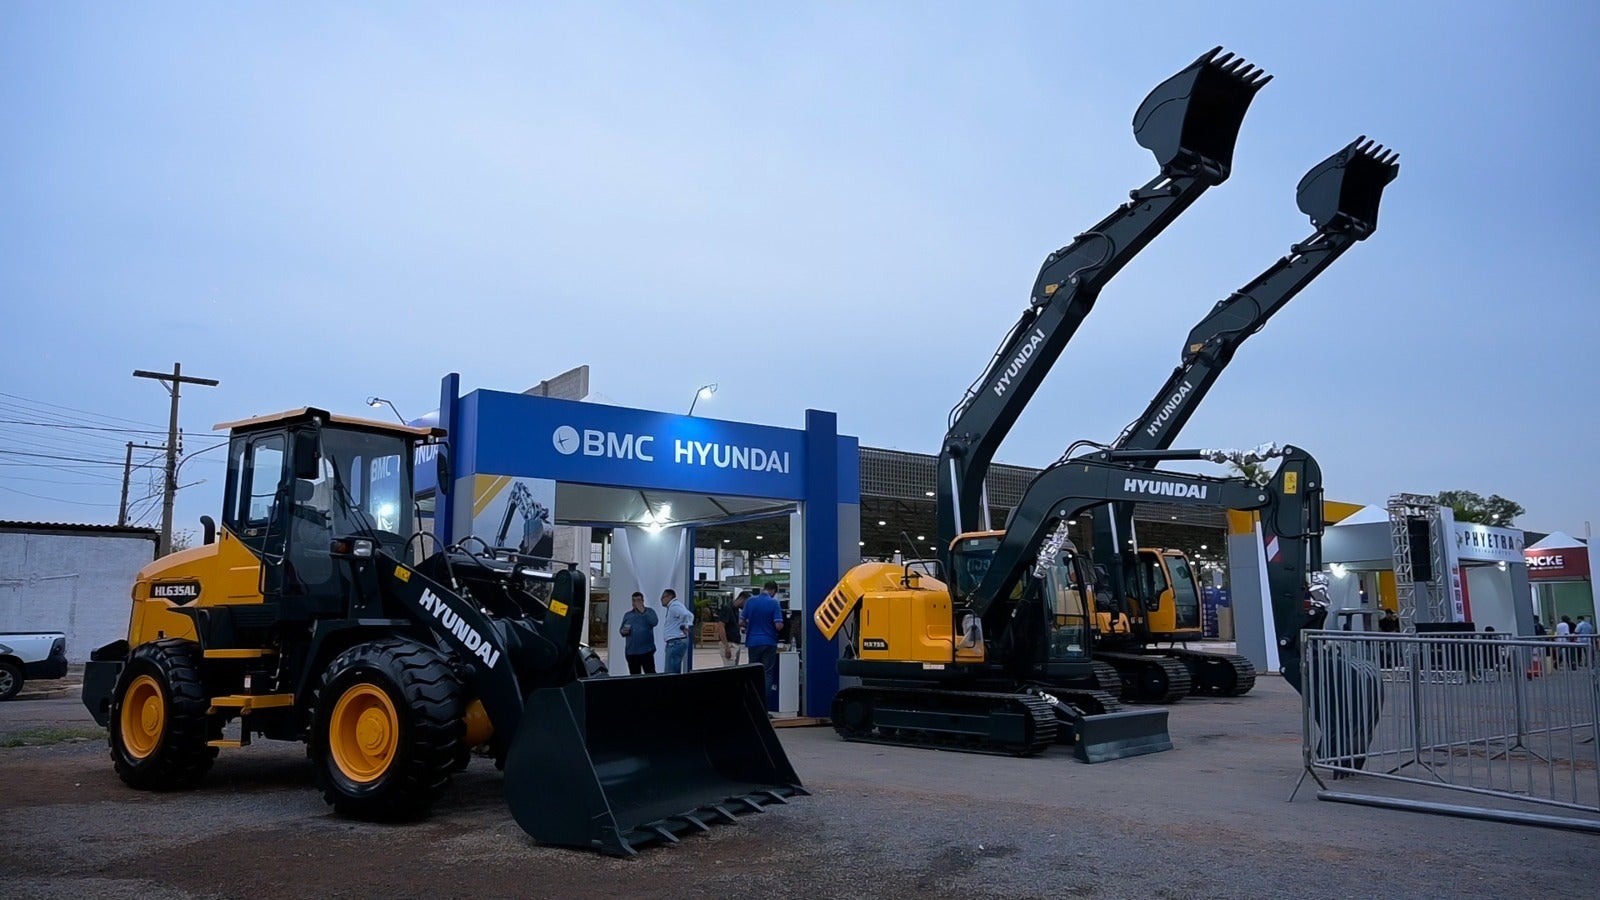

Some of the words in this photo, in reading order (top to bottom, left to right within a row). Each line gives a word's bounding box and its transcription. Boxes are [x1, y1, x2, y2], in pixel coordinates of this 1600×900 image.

[994, 328, 1045, 397] HYUNDAI
[1147, 381, 1192, 437] HYUNDAI
[583, 429, 654, 461] BMC
[674, 439, 790, 474] HYUNDAI
[1124, 478, 1208, 499] HYUNDAI
[1464, 531, 1515, 551] PHYETRA
[154, 585, 197, 597] HL635AL
[418, 587, 501, 669] HYUNDAI
